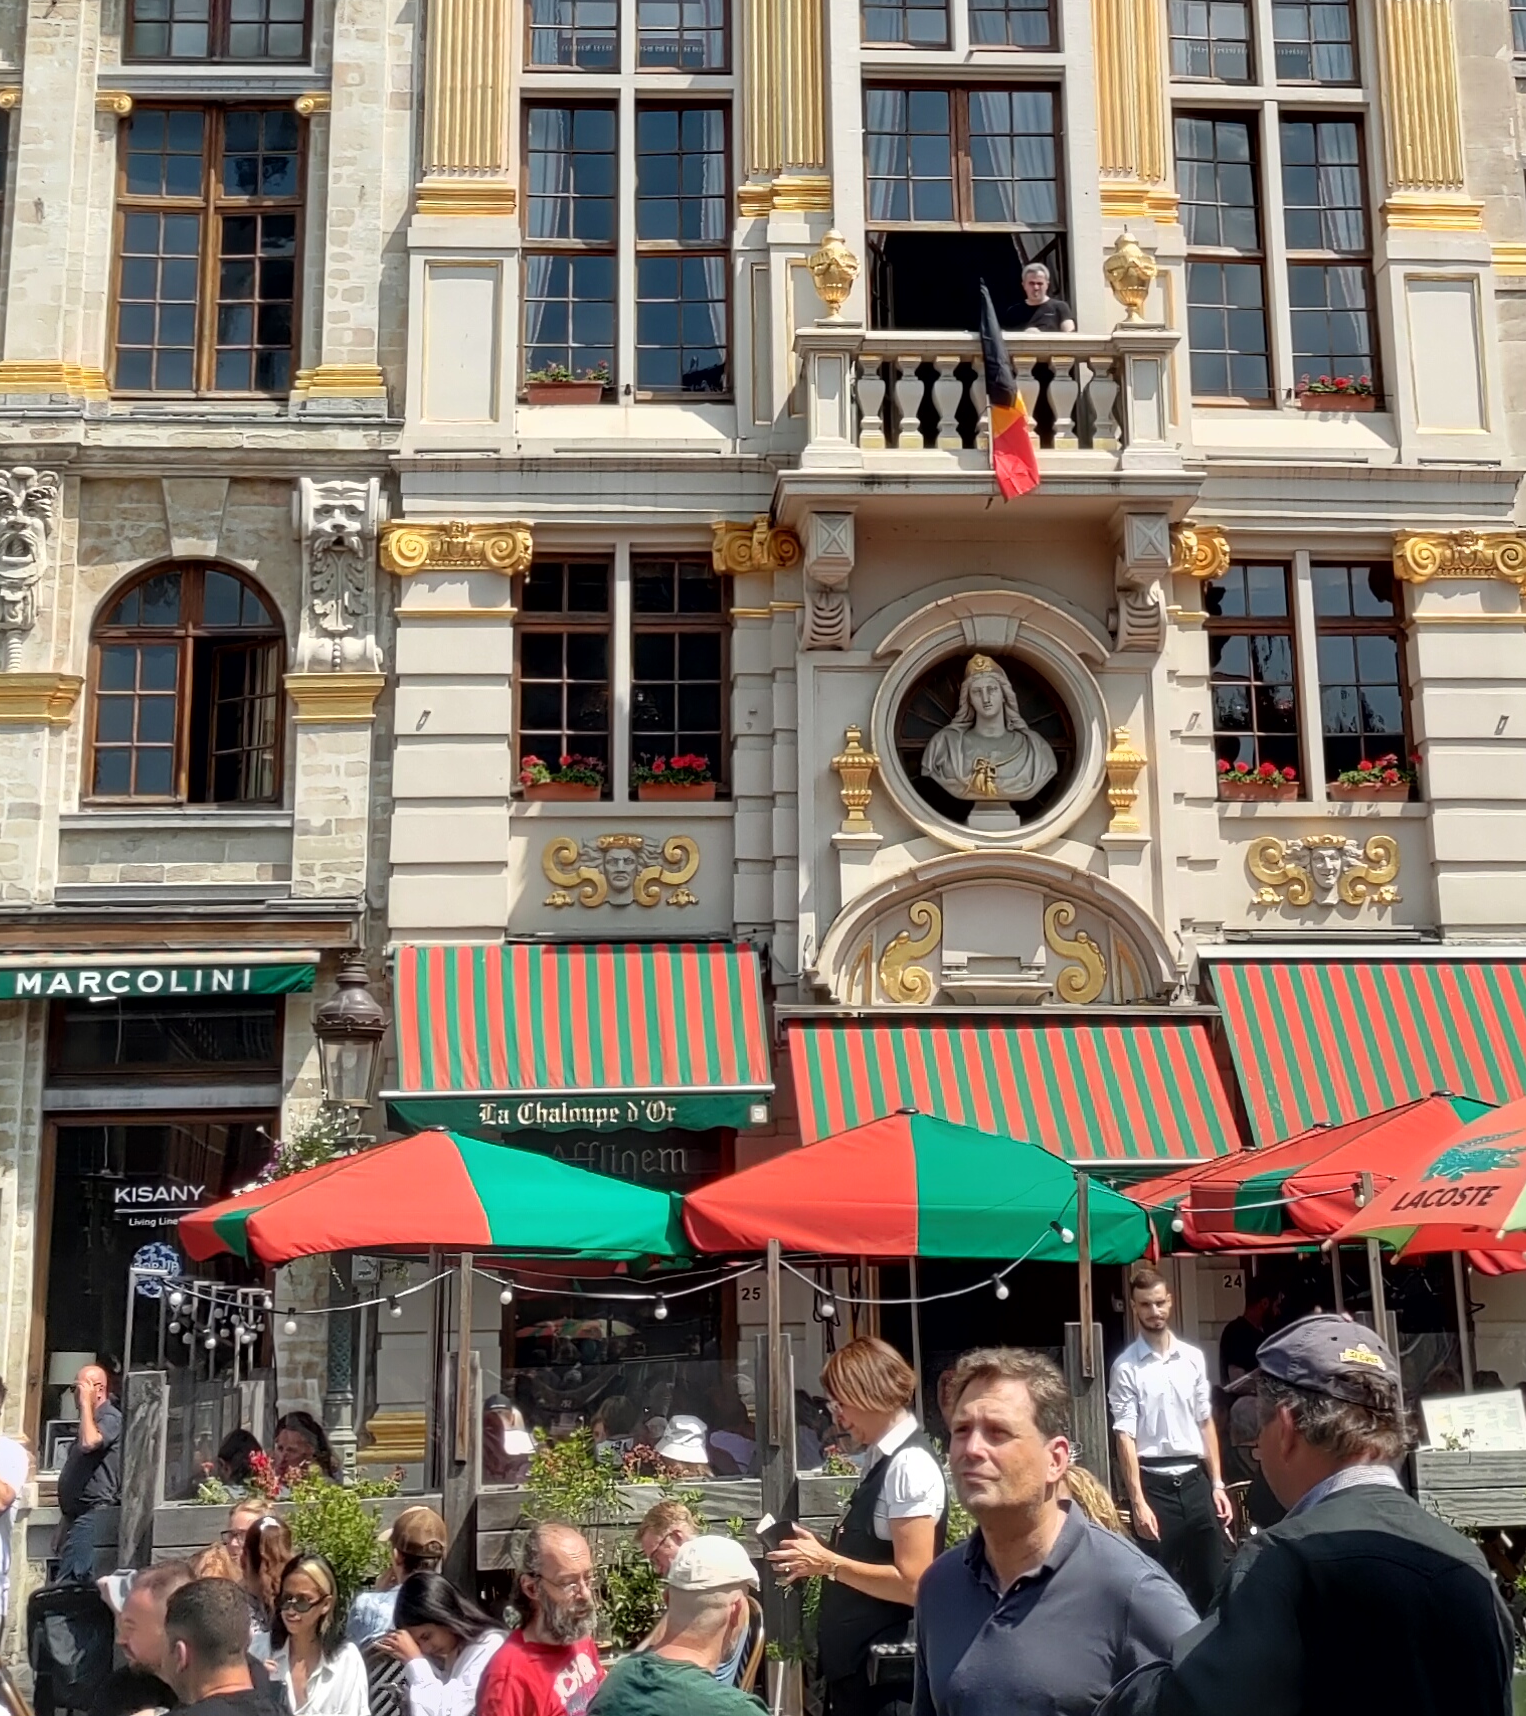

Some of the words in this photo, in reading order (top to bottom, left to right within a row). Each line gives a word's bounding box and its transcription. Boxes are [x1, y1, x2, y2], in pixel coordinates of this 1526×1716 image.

[16, 968, 252, 995] MARCOLINI
[479, 1103, 510, 1125] La
[517, 1101, 621, 1128] Chaloupe
[114, 1185, 205, 1203] KISANY
[1391, 1186, 1502, 1211] LACOSTE
[128, 1217, 156, 1227] Living
[1224, 1275, 1242, 1288] 24
[741, 1287, 761, 1301] 25
